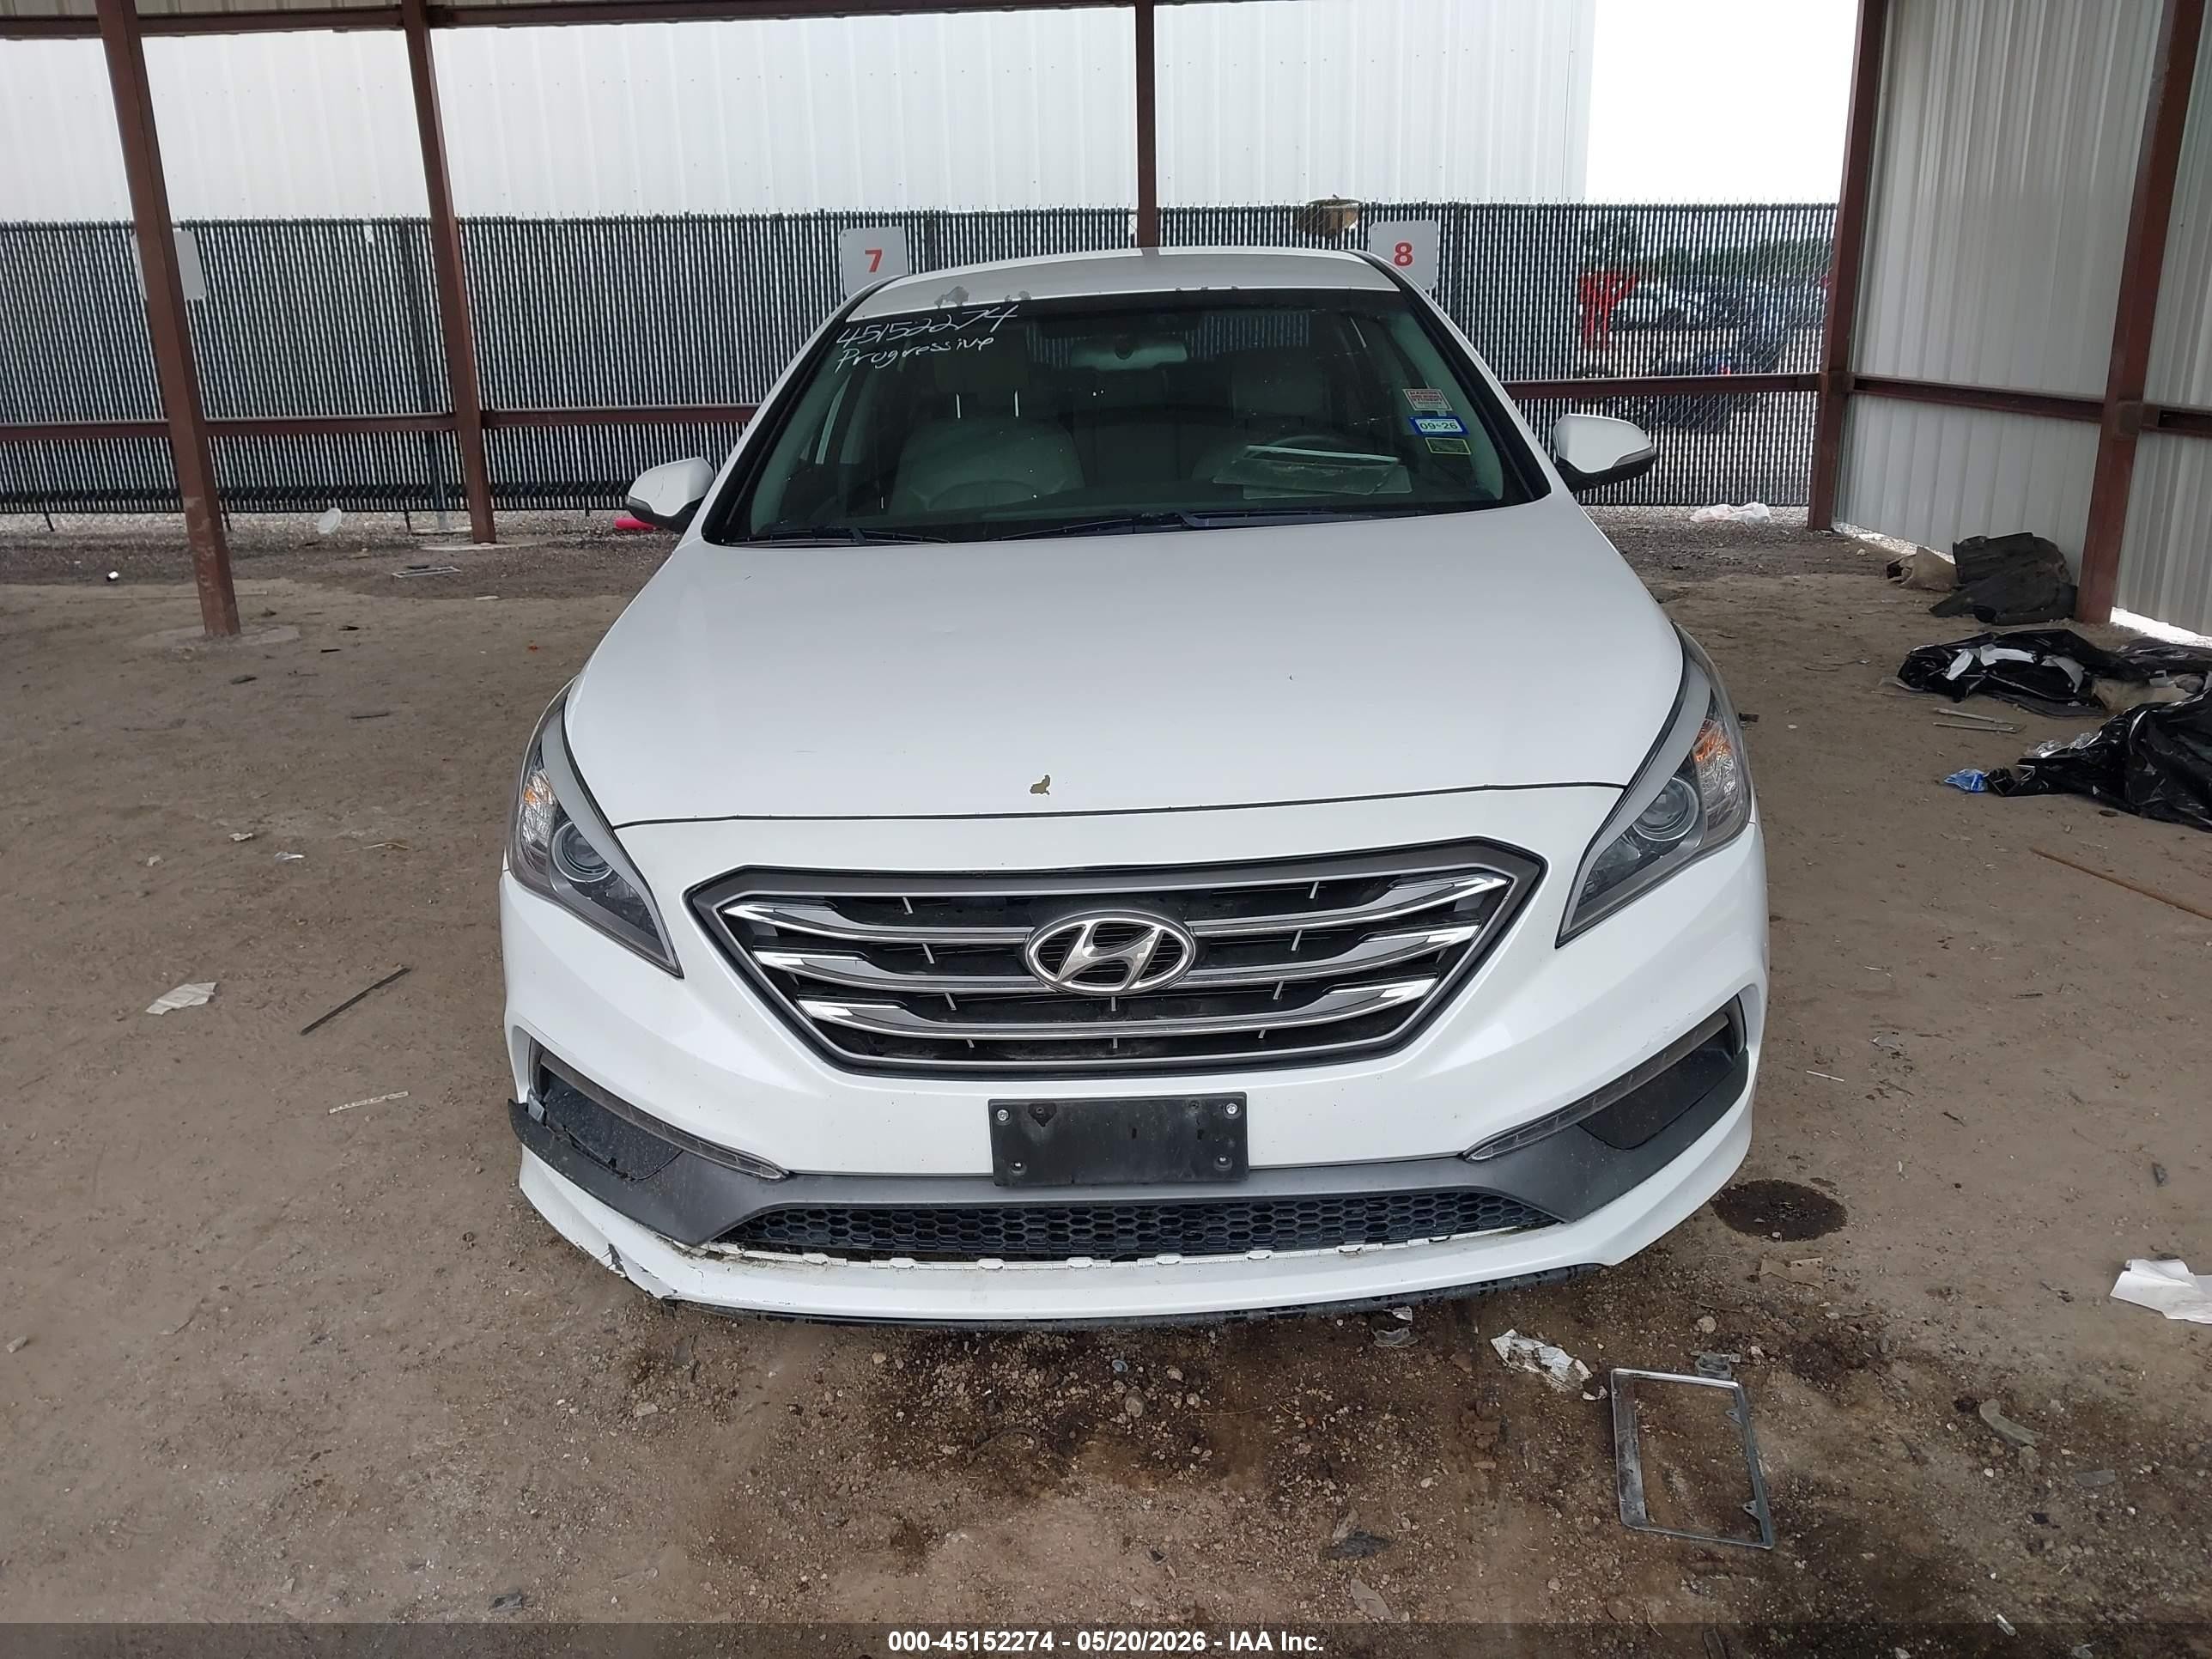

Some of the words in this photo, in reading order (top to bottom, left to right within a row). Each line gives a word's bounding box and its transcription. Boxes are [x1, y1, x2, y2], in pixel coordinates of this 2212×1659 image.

[865, 249, 883, 273] 7
[1394, 242, 1413, 266] 8
[836, 305, 1019, 349] 45152274
